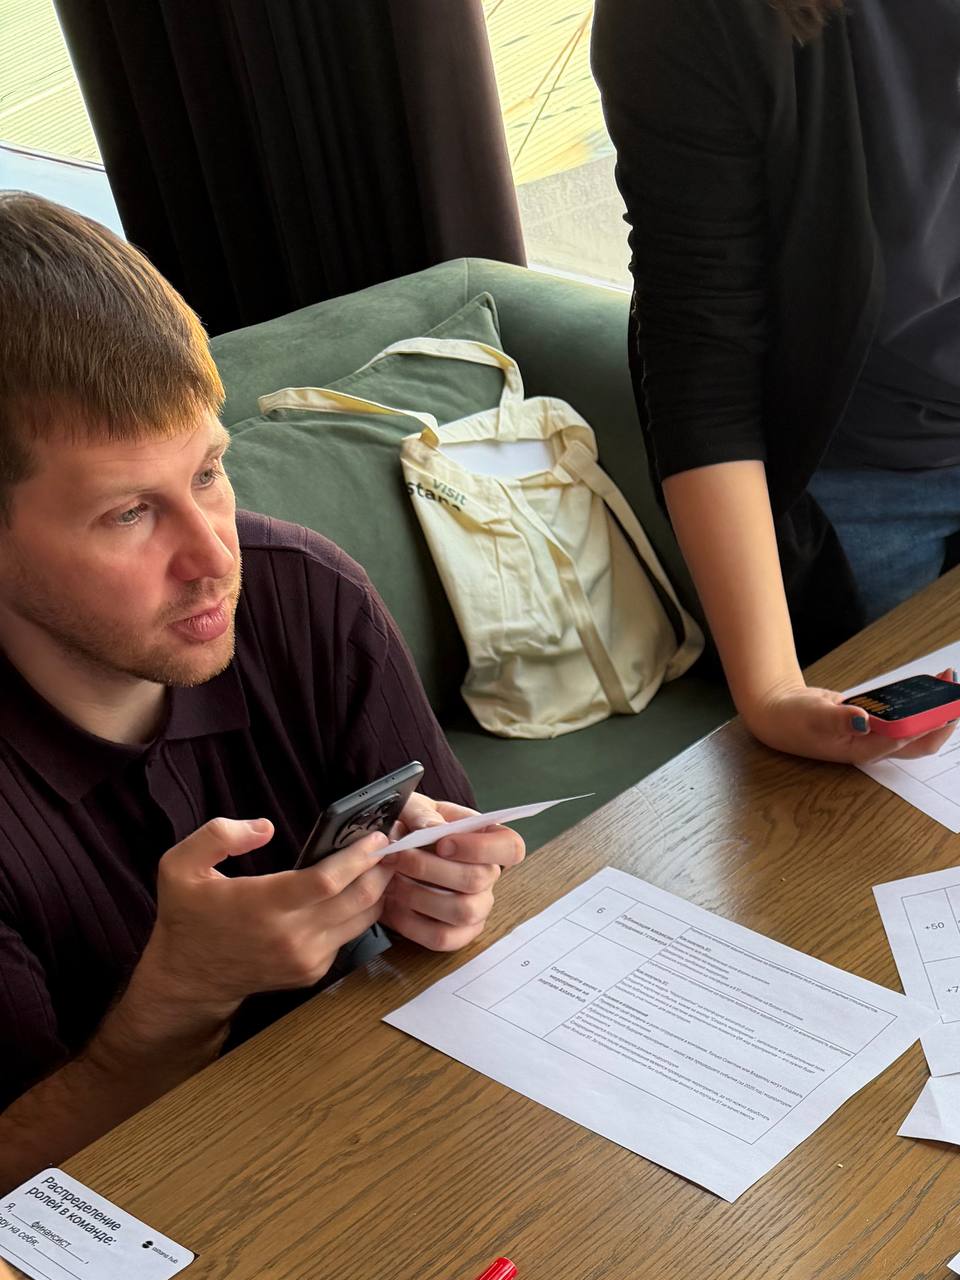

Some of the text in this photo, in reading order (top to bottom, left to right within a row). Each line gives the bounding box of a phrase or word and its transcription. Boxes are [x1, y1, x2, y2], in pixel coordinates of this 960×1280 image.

[433, 479, 468, 505] visit
[924, 921, 945, 931] +50
[5, 1202, 16, 1213] Я,
[41, 1176, 121, 1231] Распределение
[25, 1187, 117, 1246] ролей в команде:
[9, 1224, 20, 1233] на
[18, 1231, 39, 1247] себя:
